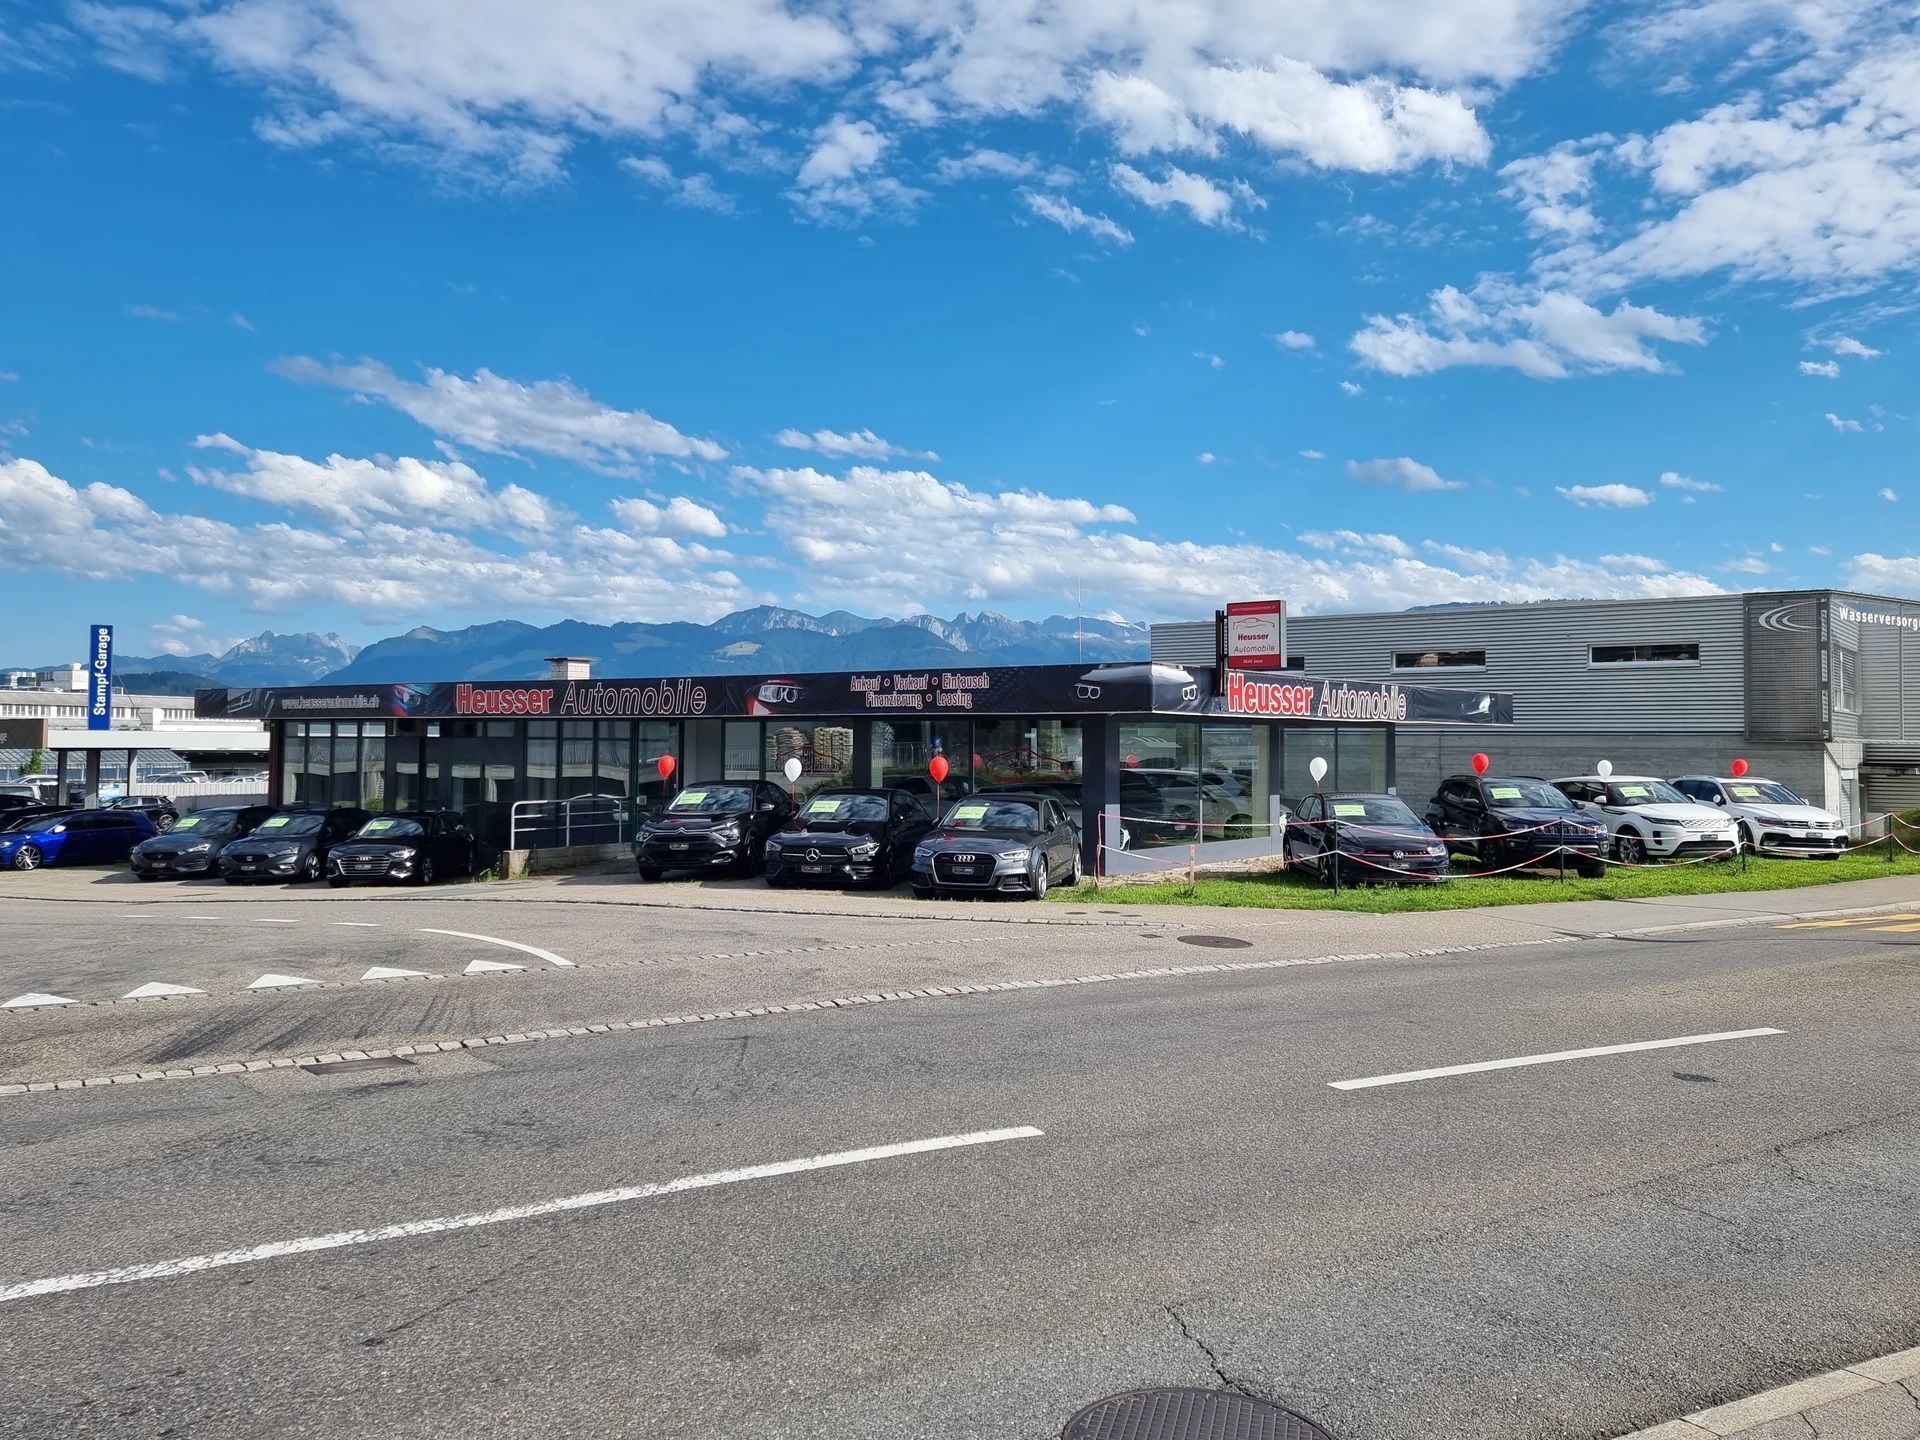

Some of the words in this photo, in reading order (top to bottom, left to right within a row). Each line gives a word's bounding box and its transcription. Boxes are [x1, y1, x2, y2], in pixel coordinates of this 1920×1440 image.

[1839, 606, 1920, 631] Wasserversorg
[1237, 633, 1269, 641] Heusser
[1233, 644, 1275, 653] Automobile
[93, 628, 111, 716] Stampf-Garage
[850, 675, 881, 691] Ankauf
[893, 674, 929, 690] Verkauf
[941, 672, 990, 689] Eintausch
[281, 694, 380, 710] www.heusserautomobile.ch
[456, 683, 553, 714] Heusser
[560, 679, 707, 715] Automobile
[865, 691, 923, 709] Finanzierung
[936, 690, 972, 709] Leasing
[1228, 673, 1313, 715] Heusser
[1317, 680, 1406, 720] Automobile
